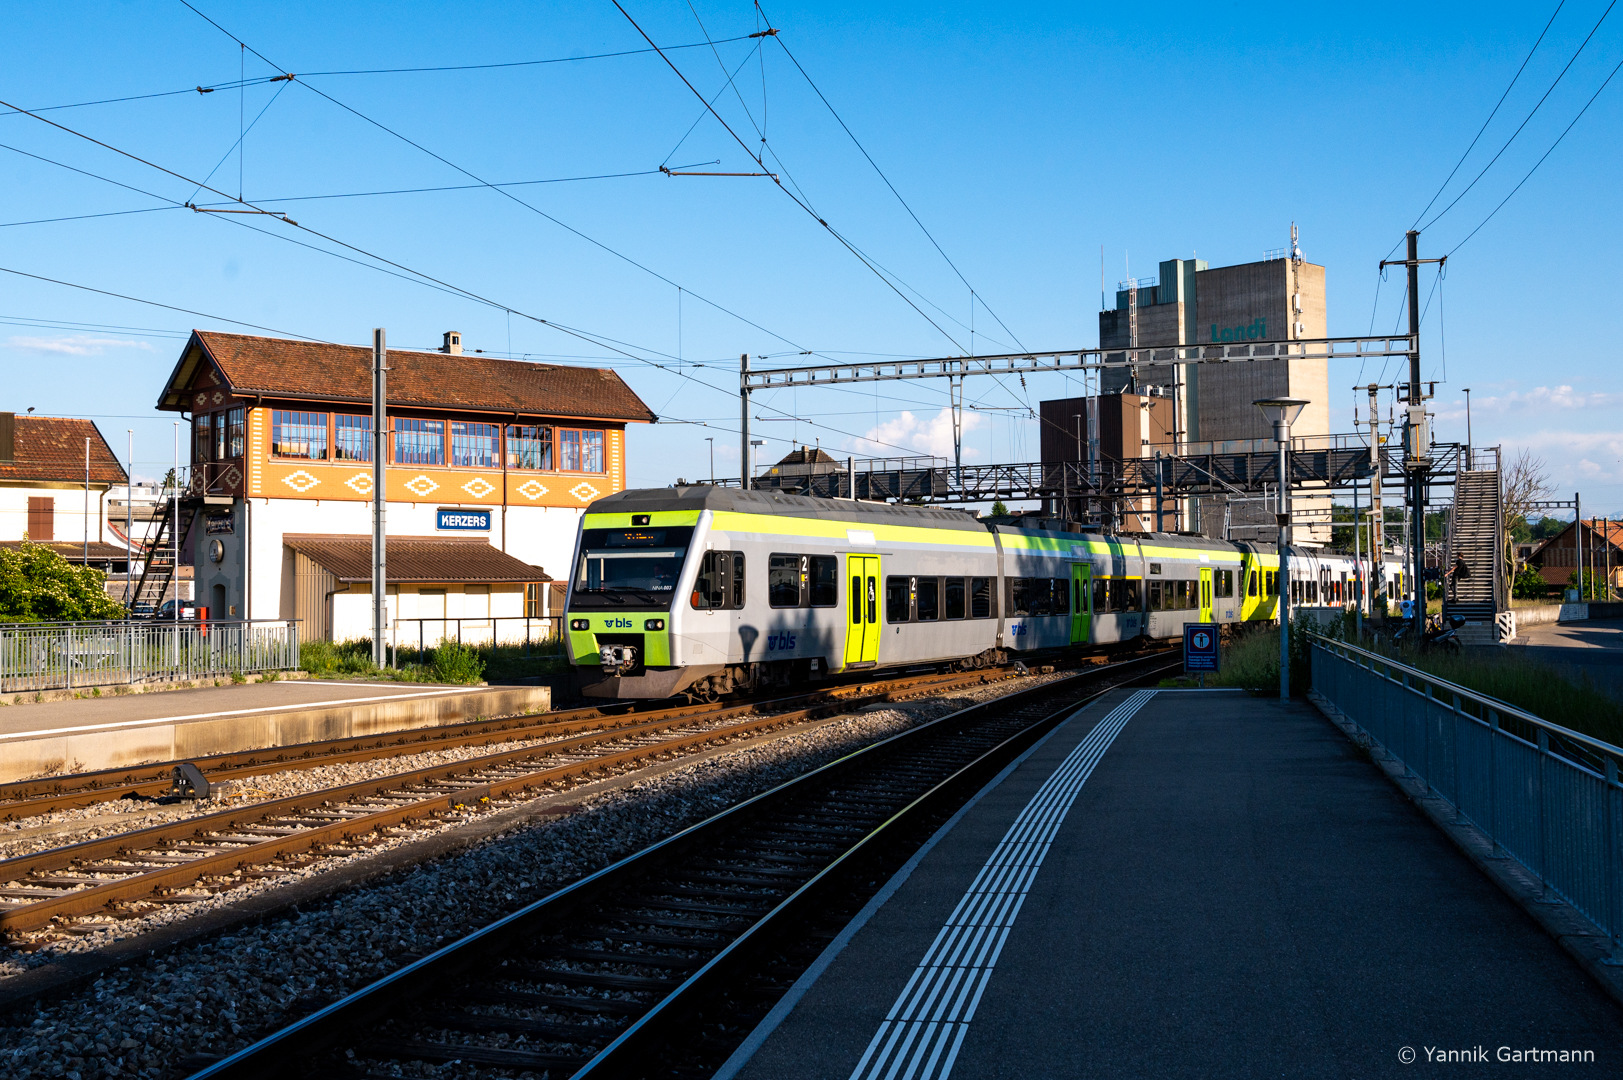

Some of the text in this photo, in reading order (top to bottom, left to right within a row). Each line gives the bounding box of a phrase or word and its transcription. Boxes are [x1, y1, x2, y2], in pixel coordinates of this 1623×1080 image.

[1211, 317, 1266, 343] Landi
[441, 514, 487, 527] KERZERS
[801, 555, 808, 572] 2
[911, 576, 916, 591] 2
[615, 618, 633, 628] bls
[778, 631, 796, 650] bls
